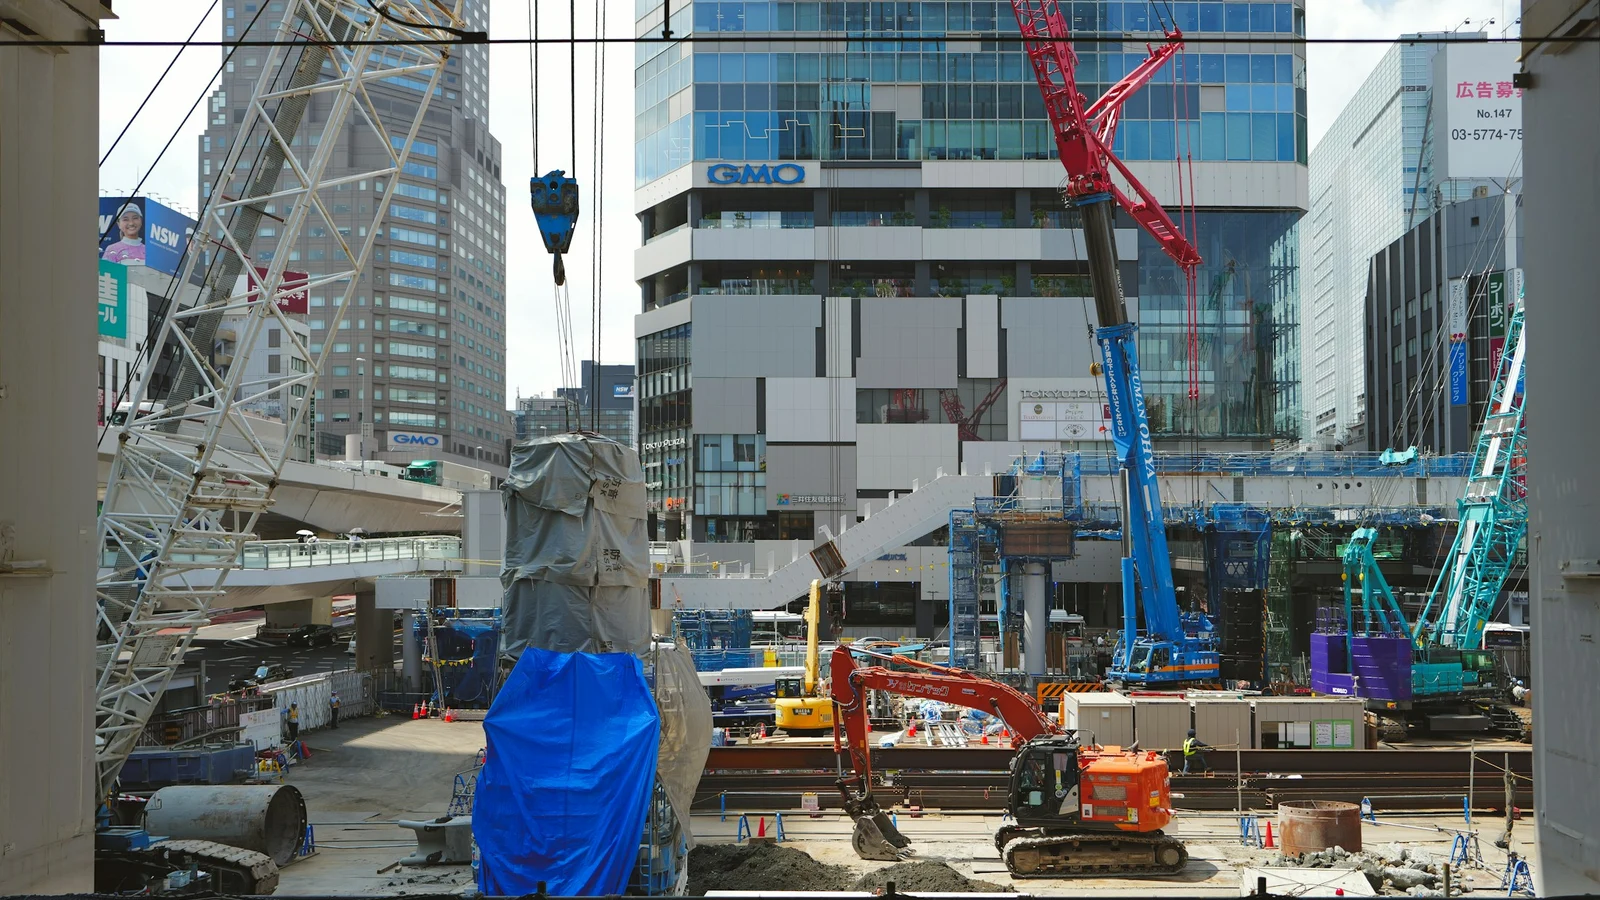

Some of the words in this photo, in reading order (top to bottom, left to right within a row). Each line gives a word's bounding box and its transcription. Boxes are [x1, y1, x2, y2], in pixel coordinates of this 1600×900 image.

[1476, 108, 1512, 119] No.147
[707, 163, 805, 185] GMO
[150, 223, 179, 248] NSW
[1020, 390, 1071, 398] TOKYU
[394, 434, 439, 446] GMO
[642, 441, 662, 450] TOKYU
[663, 438, 686, 447] PLAZA
[1139, 422, 1155, 480] OHYA
